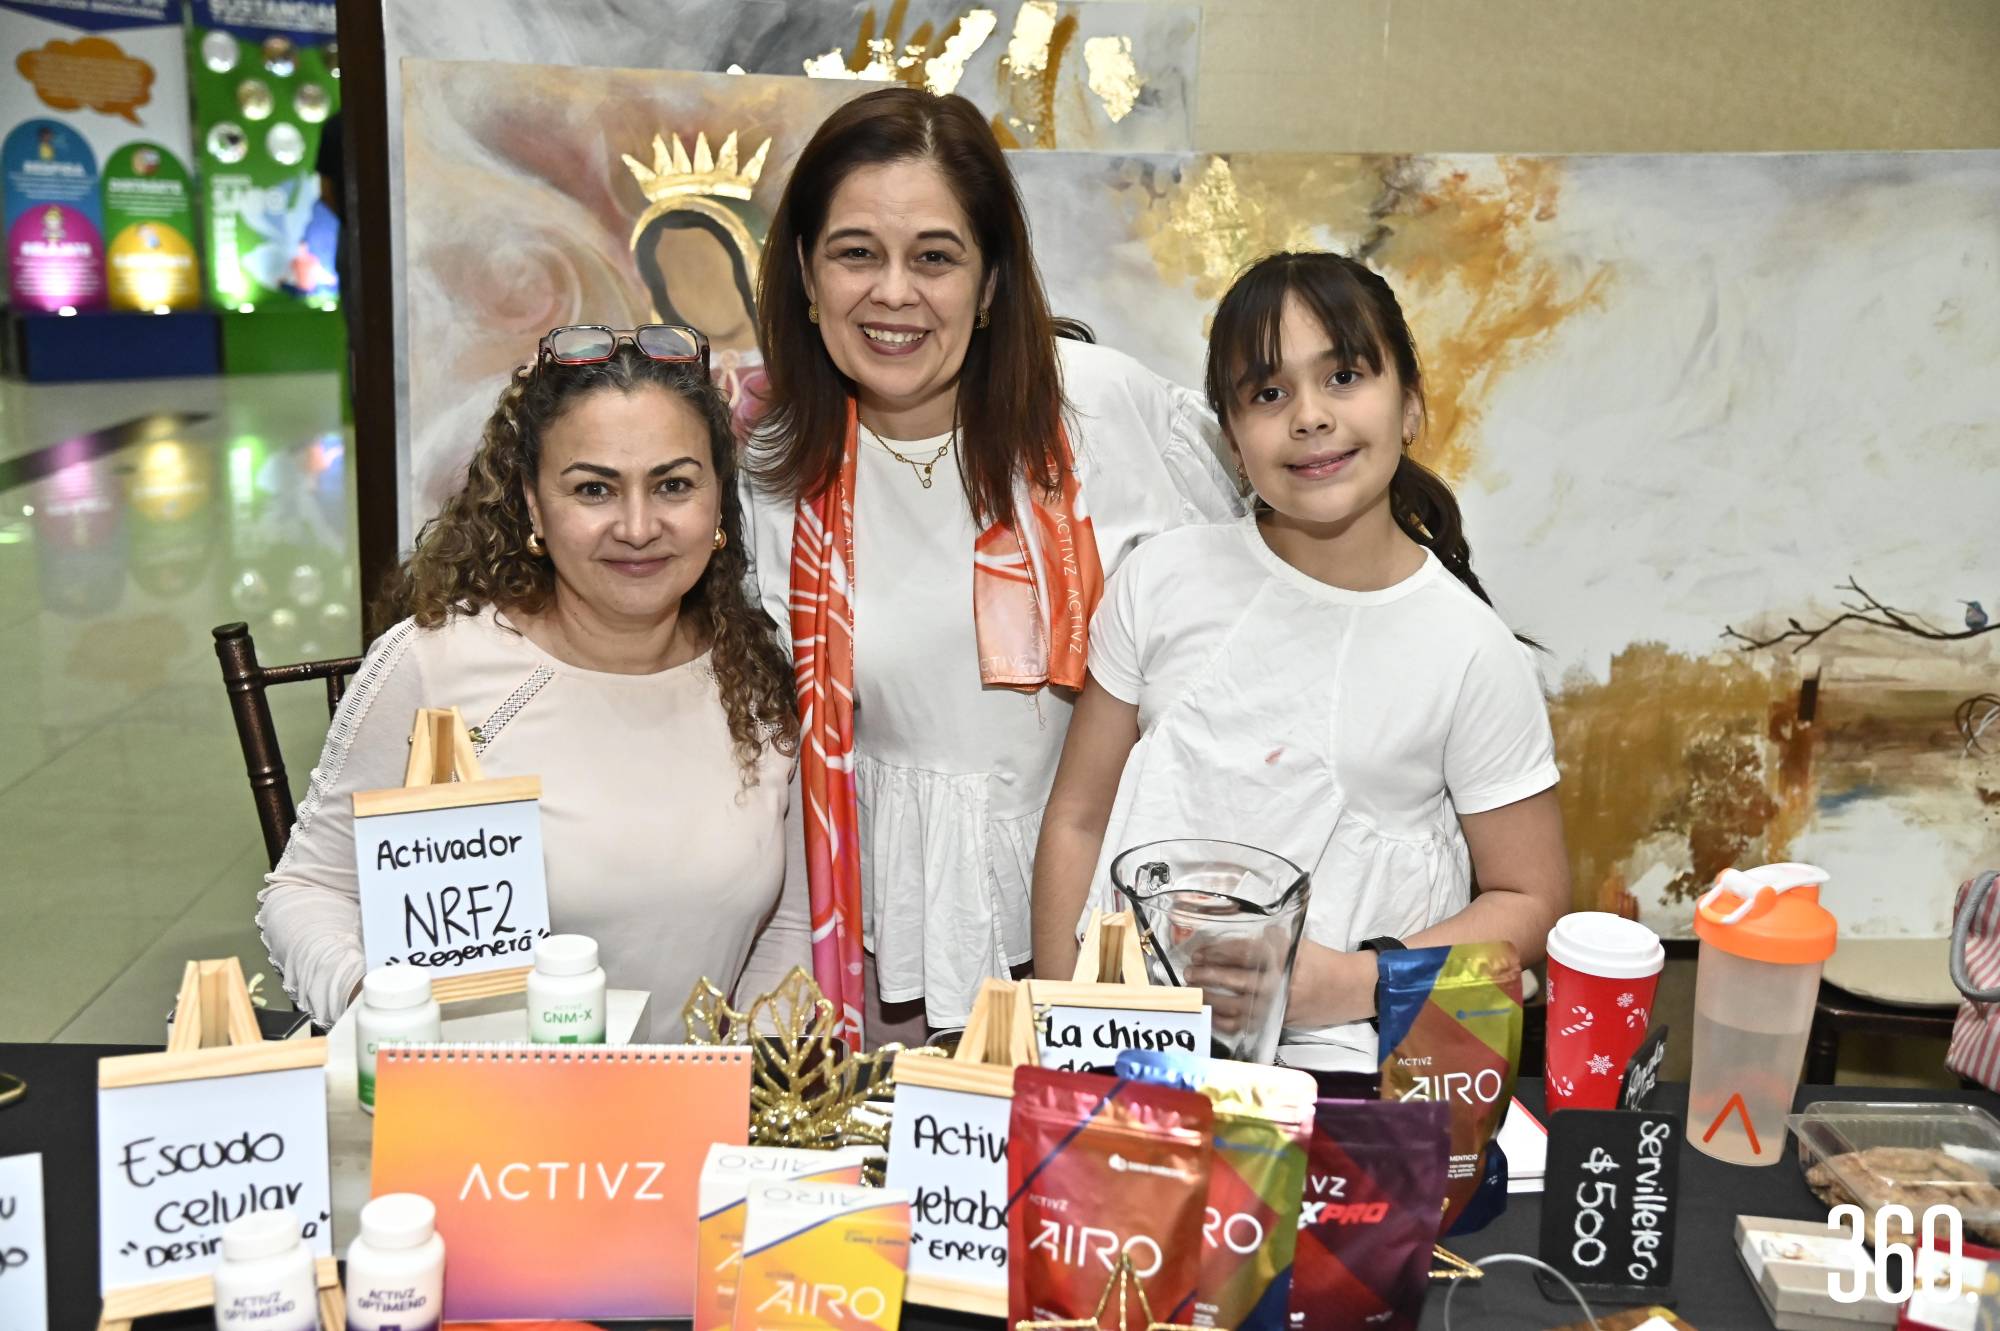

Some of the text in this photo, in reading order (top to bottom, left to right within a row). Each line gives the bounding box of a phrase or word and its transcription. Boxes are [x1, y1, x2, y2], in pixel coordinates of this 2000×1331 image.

[1055, 512, 1083, 655] ACTIVZ ACTIVZ
[377, 829, 522, 870] Activador
[404, 880, 516, 948] NRF2
[543, 1008, 593, 1024] GNM-X
[1045, 1016, 1082, 1048] La
[1397, 1056, 1433, 1066] ACTIVZ
[1400, 1068, 1502, 1105] AIRO
[118, 1132, 284, 1187] Escudo
[1449, 1153, 1478, 1162] MENTICIO
[458, 1161, 666, 1201] ACTIVZ
[1030, 1218, 1163, 1279] AIRO
[1202, 1205, 1264, 1255] RO
[369, 1287, 416, 1300] ACTIVZ
[755, 1279, 886, 1321] AIRO
